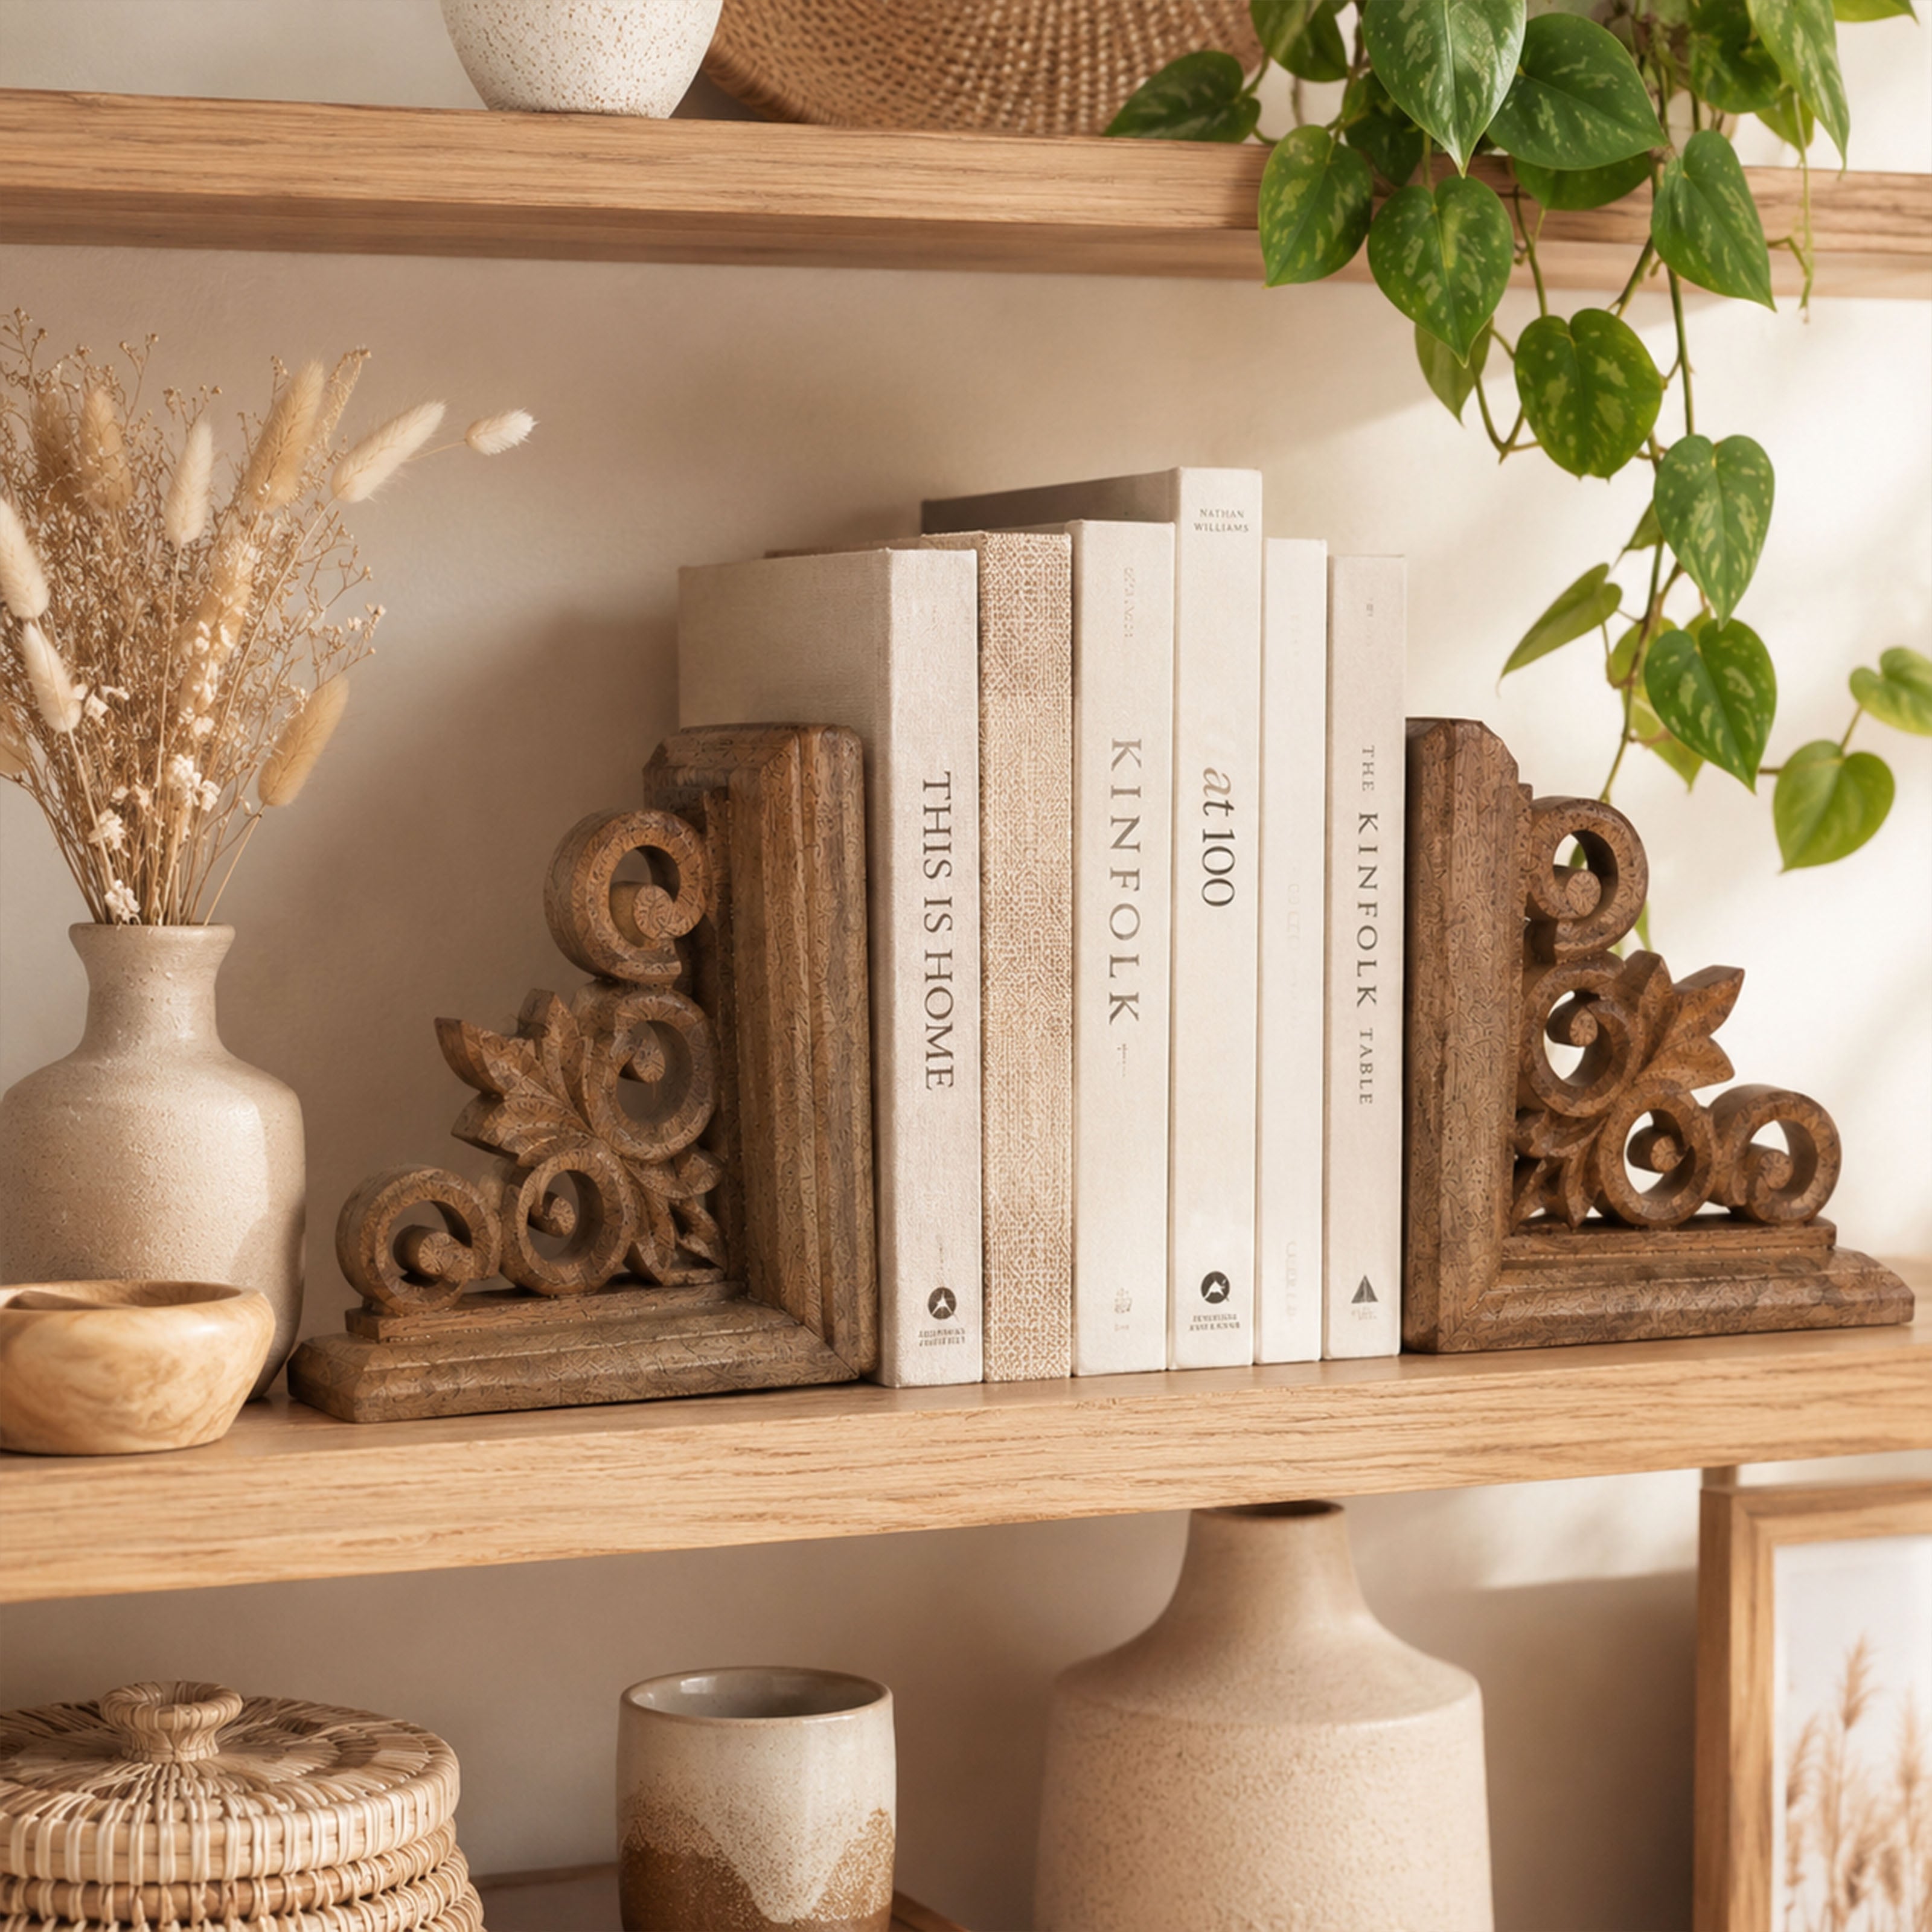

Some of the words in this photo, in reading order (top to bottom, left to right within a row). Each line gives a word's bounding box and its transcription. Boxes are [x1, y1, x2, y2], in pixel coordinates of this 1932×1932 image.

[1194, 522, 1249, 533] WILLIAMS
[1199, 508, 1244, 518] NATHAN
[1202, 767, 1235, 817] at
[1361, 745, 1375, 791] THE
[922, 770, 953, 880] THIS
[1108, 739, 1142, 1025] KINFOLK
[1201, 828, 1236, 907] 100
[924, 896, 953, 933] IS
[1357, 813, 1378, 1008] KINFOLK
[924, 948, 955, 1091] HOME
[1359, 1027, 1374, 1104] TABLE
